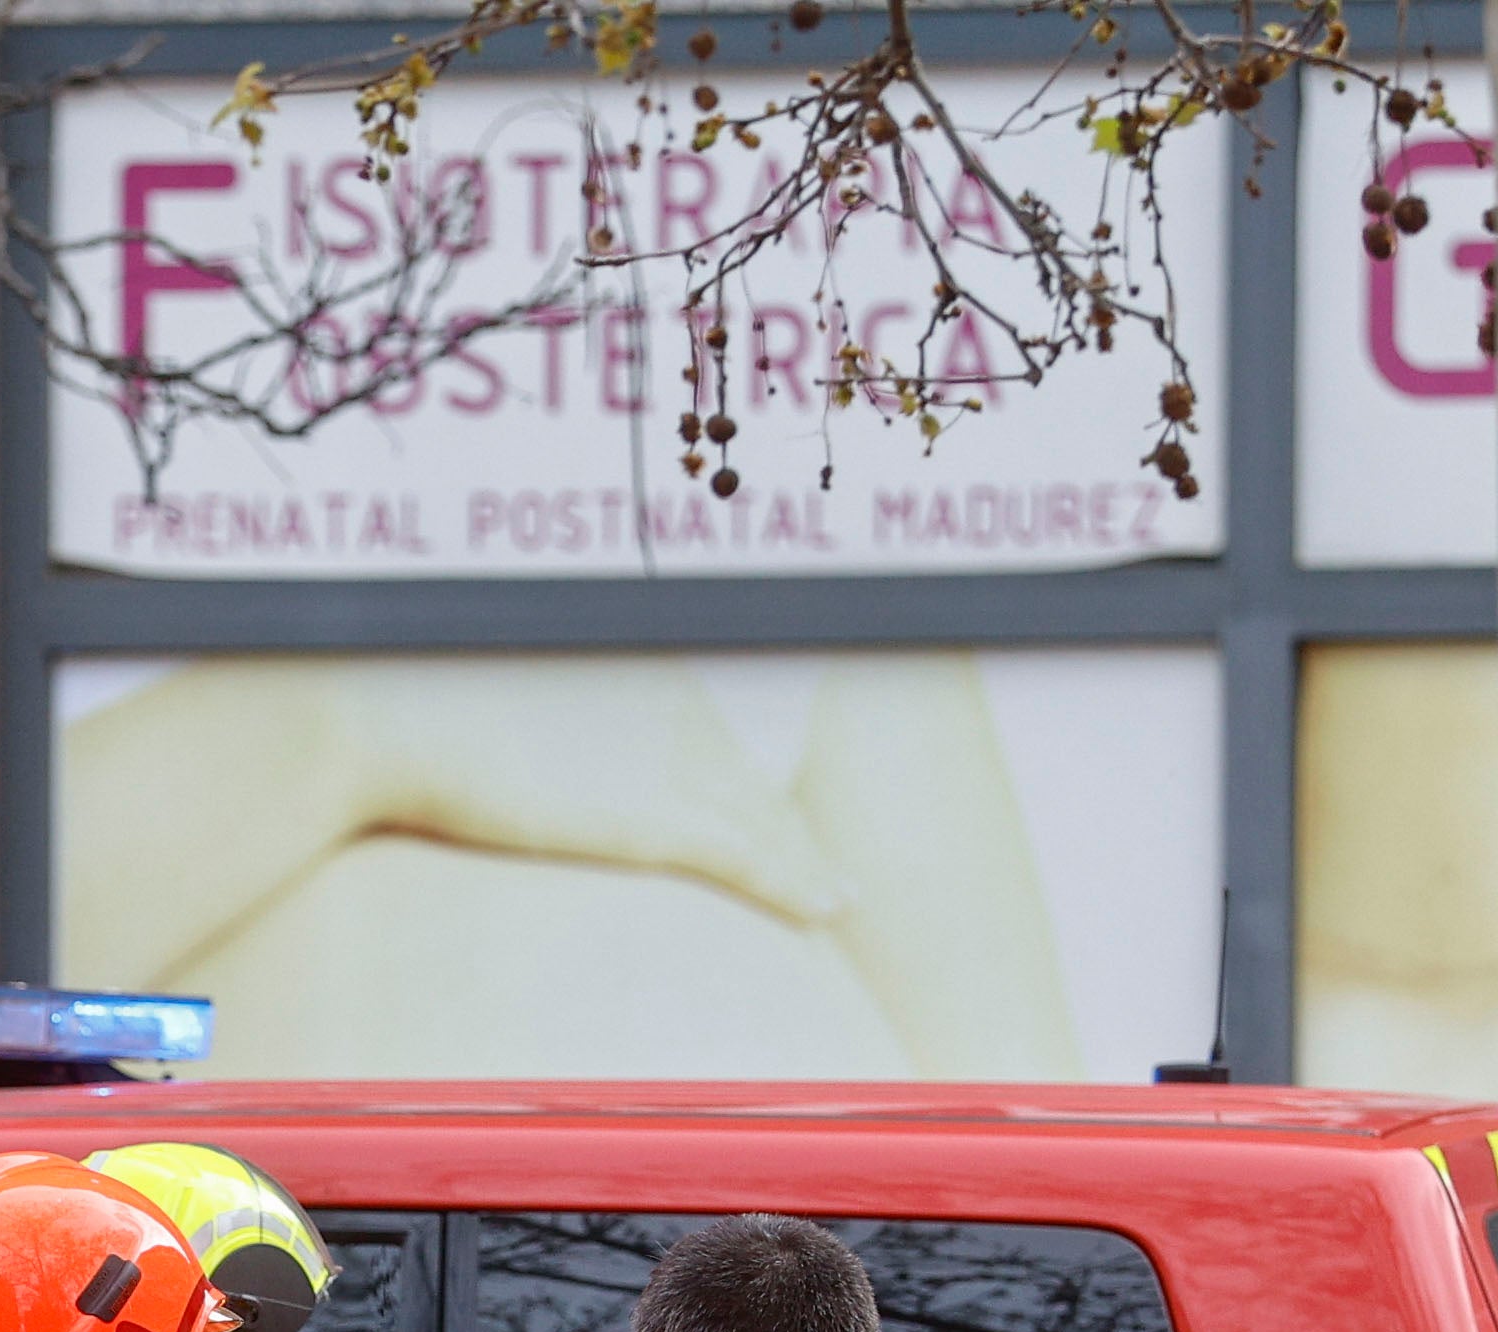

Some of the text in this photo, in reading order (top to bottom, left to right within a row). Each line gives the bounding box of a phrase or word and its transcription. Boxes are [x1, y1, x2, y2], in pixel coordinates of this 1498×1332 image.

[286, 305, 1004, 417] OBSTETRICA
[112, 481, 1166, 556] PRENATAL POSTNATAL MADUREZ
